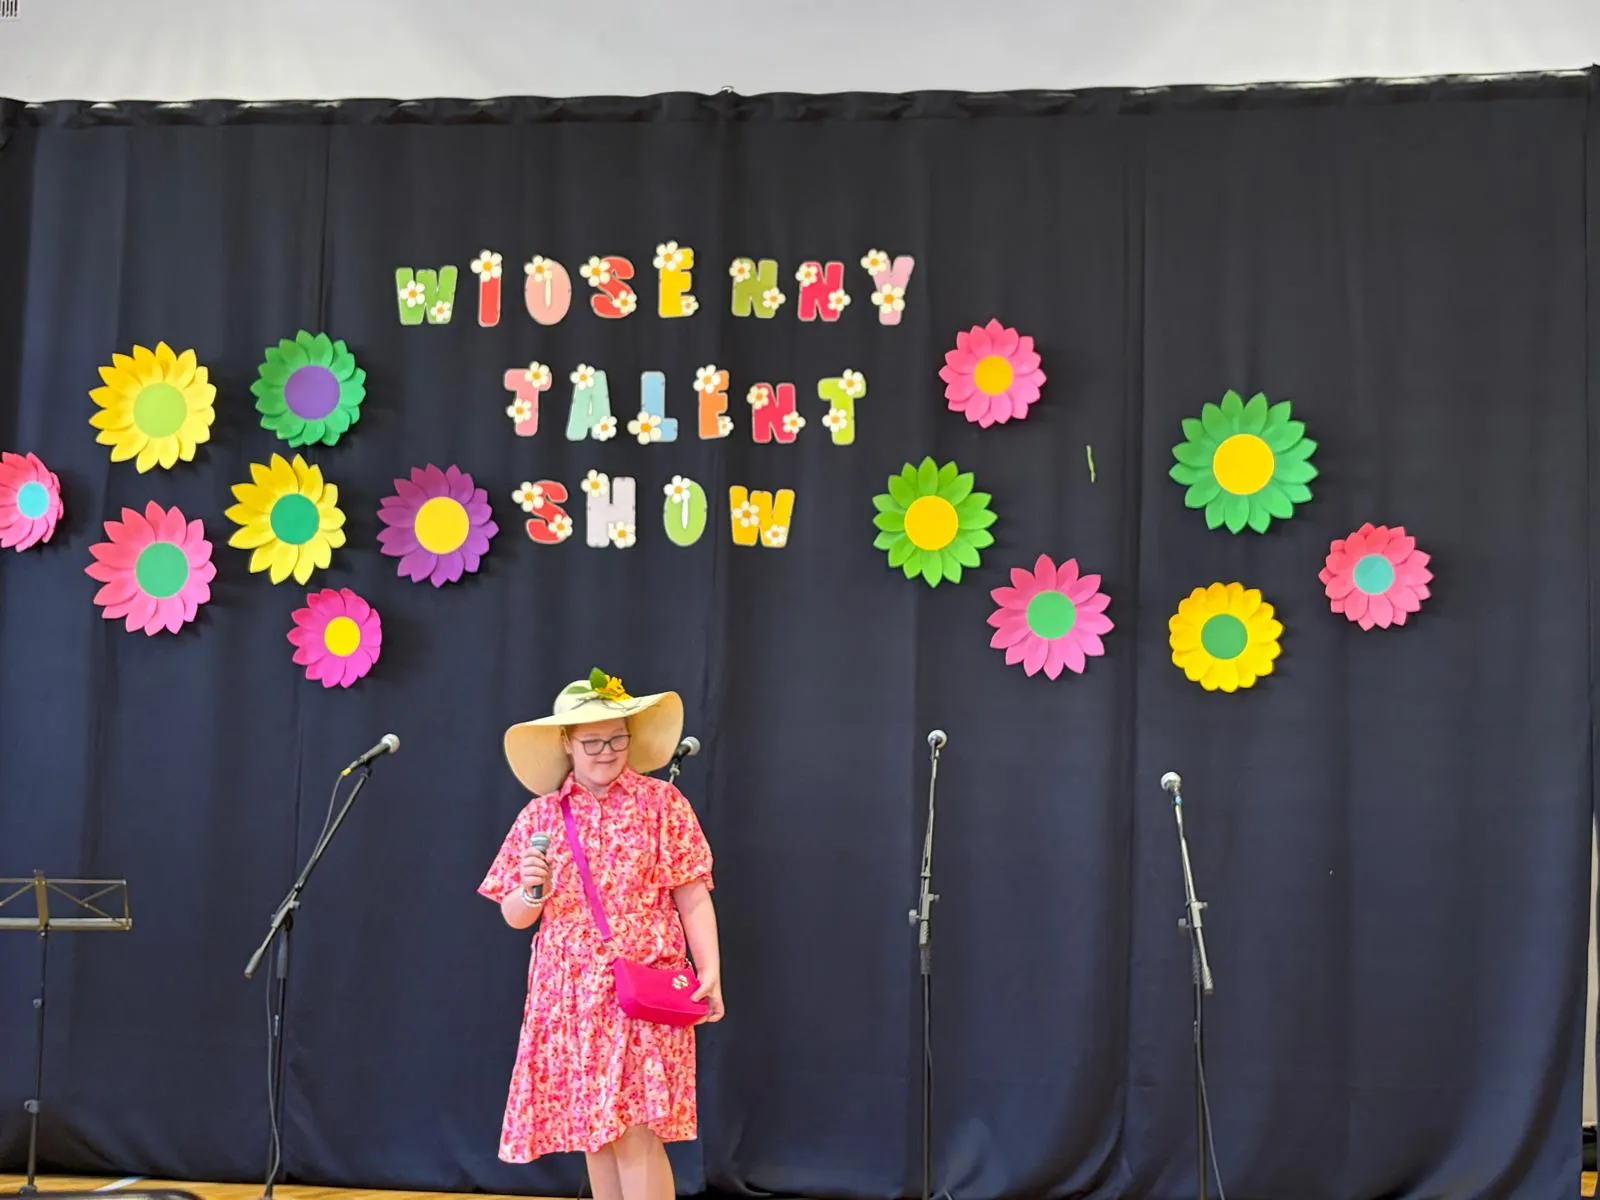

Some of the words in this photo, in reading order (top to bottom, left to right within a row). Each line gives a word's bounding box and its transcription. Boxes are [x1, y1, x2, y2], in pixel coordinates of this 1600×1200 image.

[395, 242, 914, 326] WIOSENNY
[504, 362, 866, 445] TALENT
[513, 470, 795, 547] SHOW
